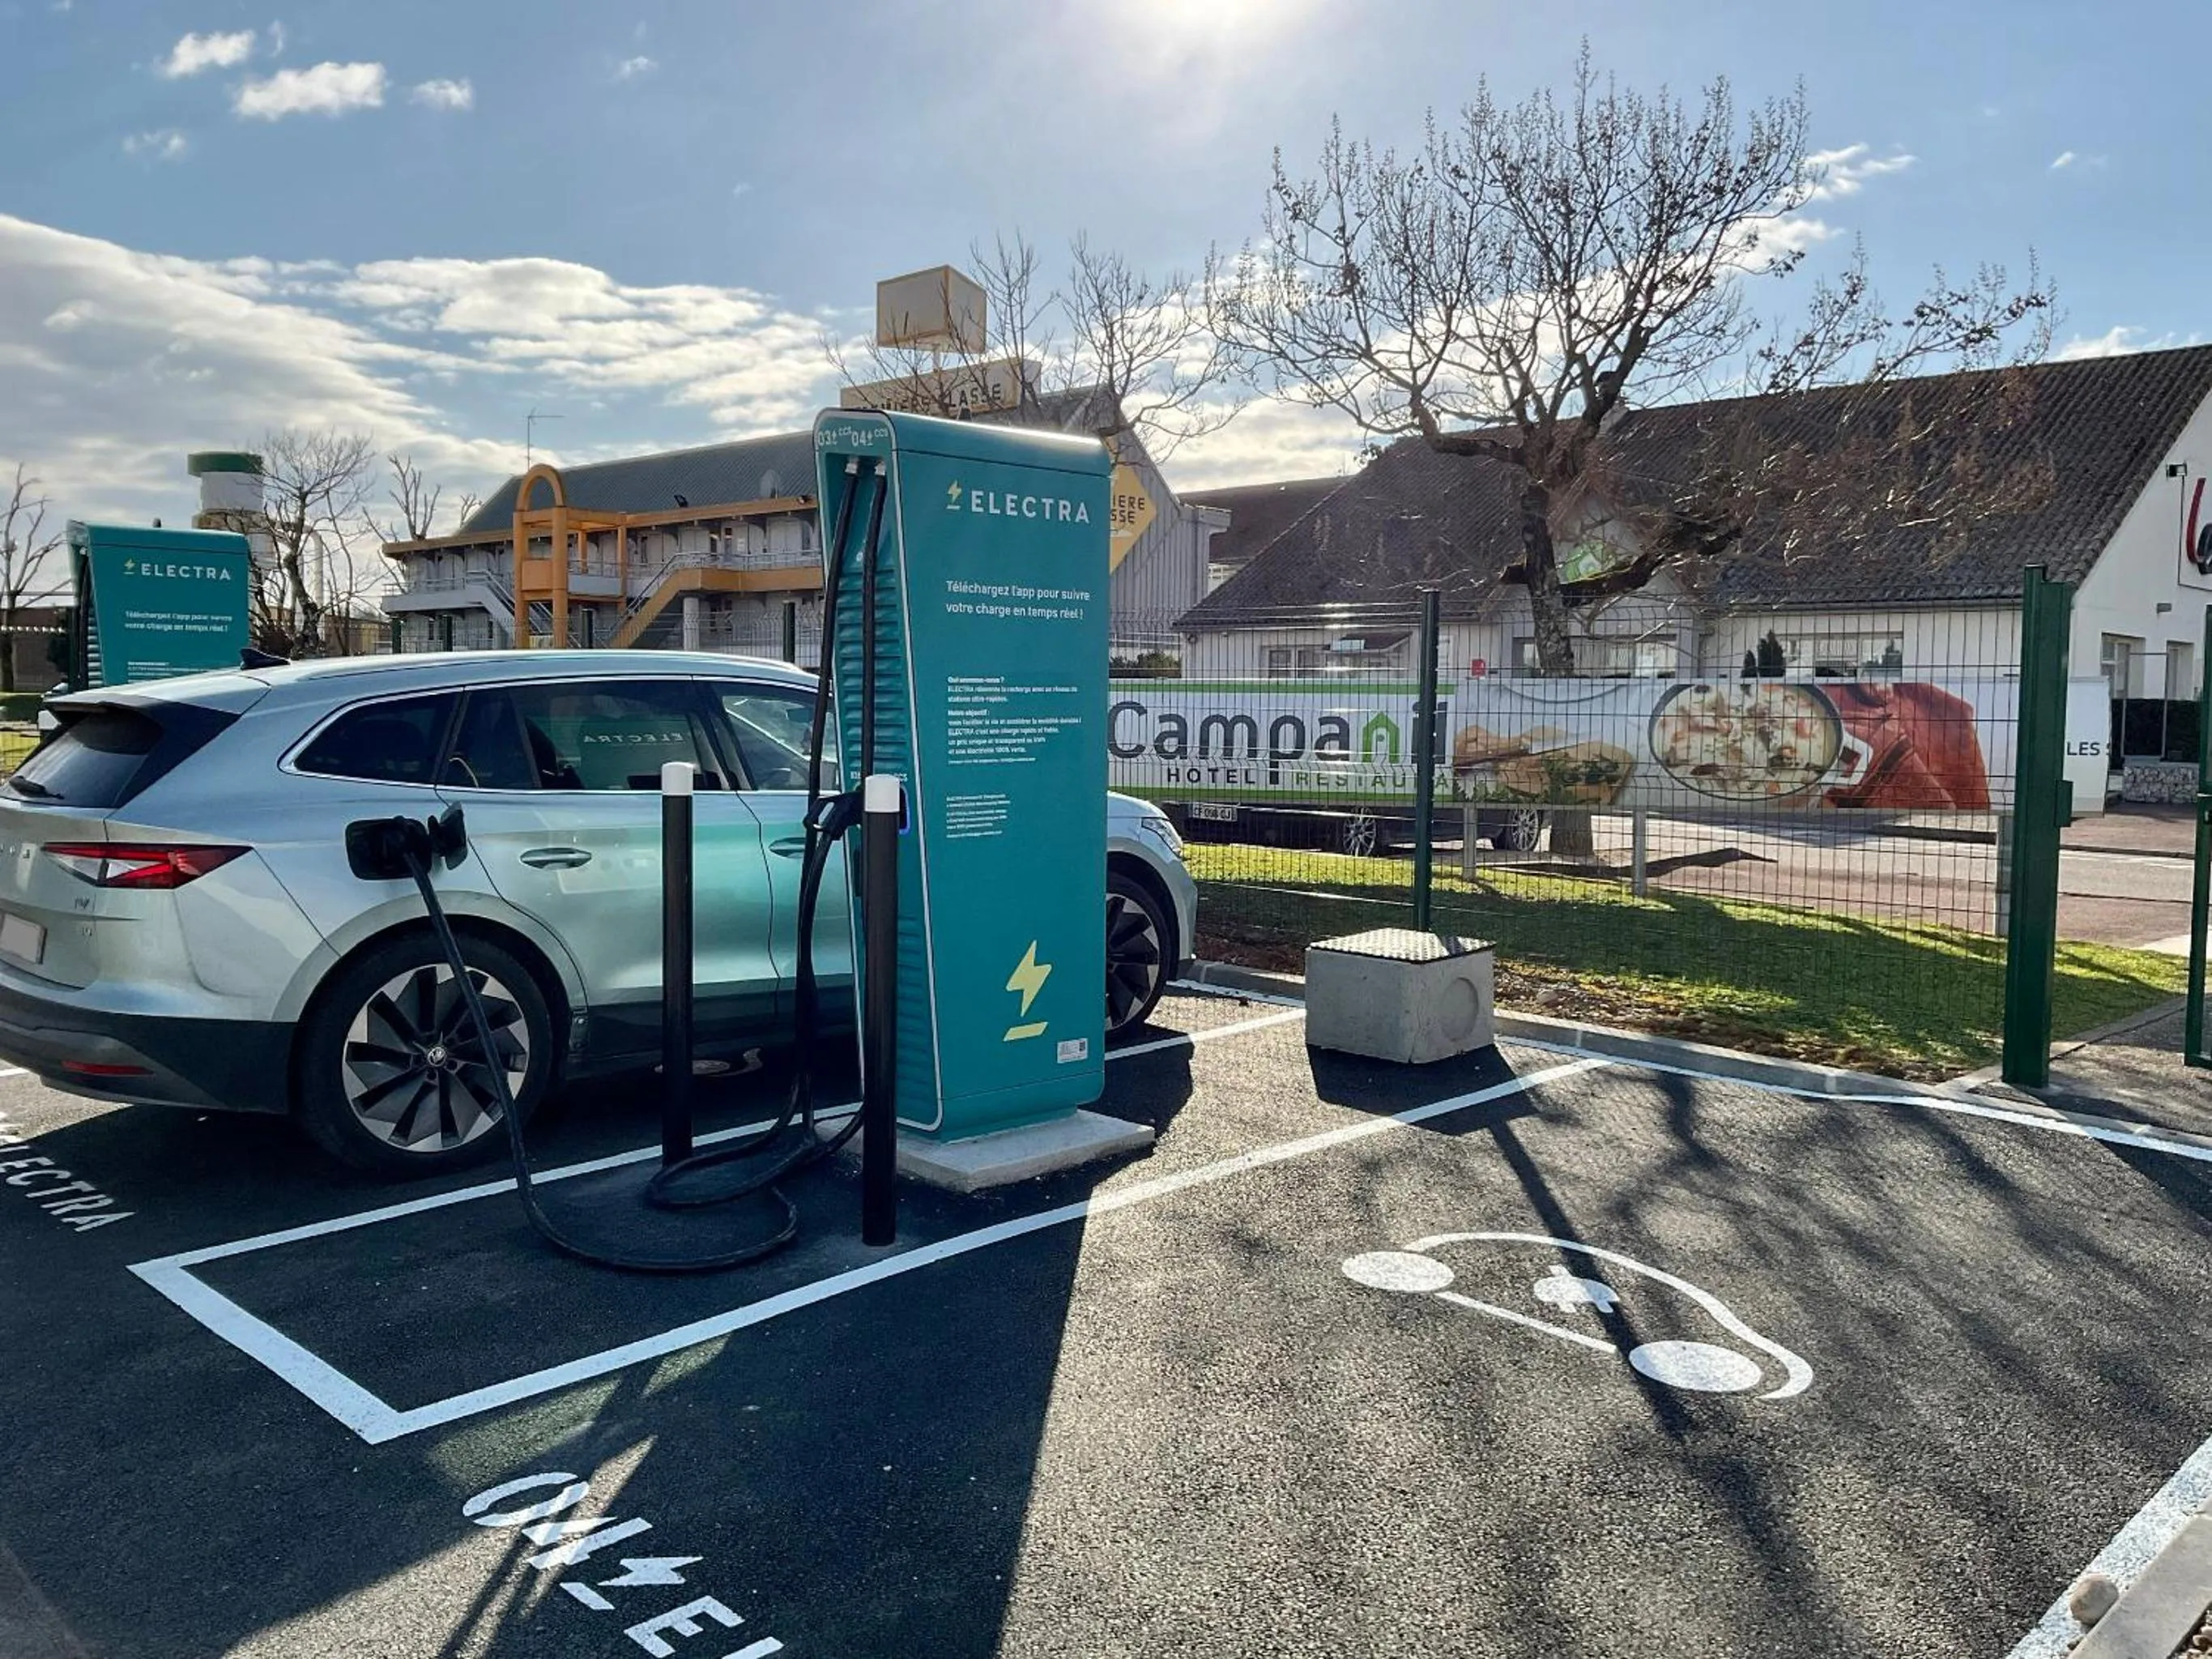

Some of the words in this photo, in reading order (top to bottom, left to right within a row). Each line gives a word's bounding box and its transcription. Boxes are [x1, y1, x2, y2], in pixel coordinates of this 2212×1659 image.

[938, 383, 1001, 408] LASSE
[818, 430, 831, 446] 03
[851, 431, 867, 447] 04
[971, 490, 1090, 524] ELECTRA
[1112, 495, 1145, 510] IERE
[1110, 508, 1136, 524] SSE
[141, 563, 232, 581] ELECTRA
[946, 580, 1009, 598] Téléchargez
[1038, 589, 1059, 600] pour
[1061, 589, 1090, 600] suivre
[946, 603, 974, 614] votre
[975, 603, 1011, 618] charge
[1013, 607, 1025, 616] en
[1028, 606, 1058, 620] temps
[1167, 767, 1255, 785] HOTEL
